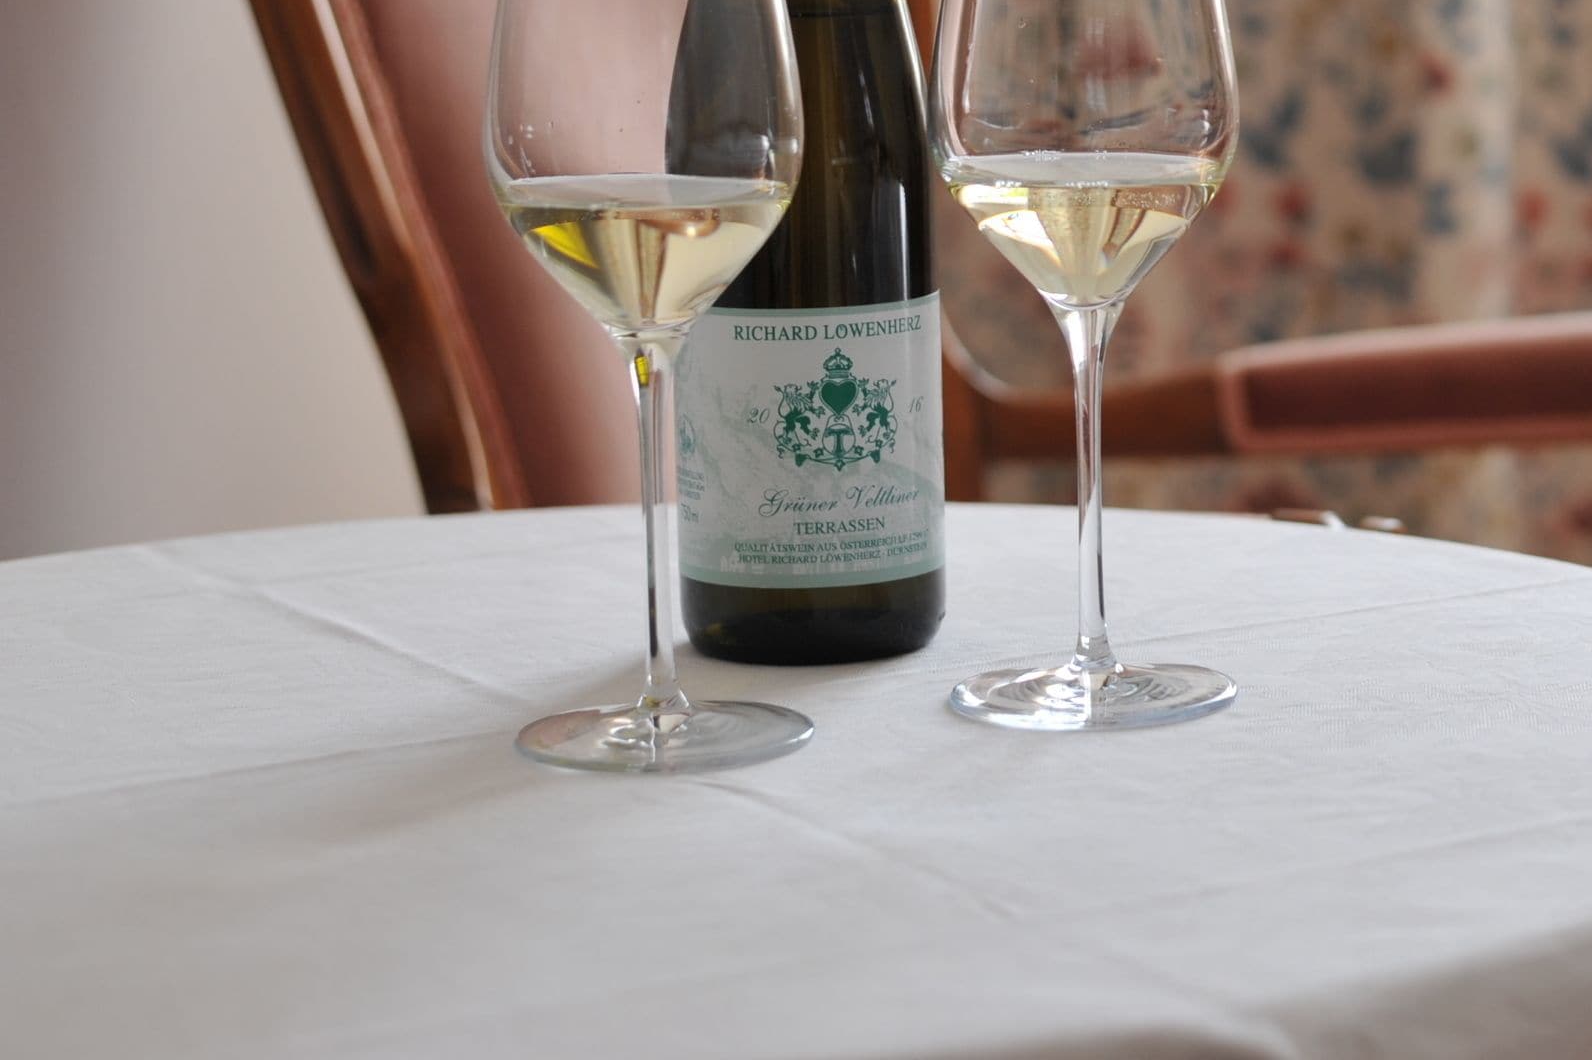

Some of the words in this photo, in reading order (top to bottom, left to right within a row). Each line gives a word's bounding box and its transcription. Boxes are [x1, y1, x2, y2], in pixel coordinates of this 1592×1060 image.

[734, 324, 817, 341] RICHARD
[909, 395, 925, 414] 16
[746, 407, 771, 425] 20
[758, 489, 839, 517] Grüner
[845, 484, 920, 510] Veltliner
[793, 516, 885, 536] TERRASSEN
[735, 542, 815, 553] QUALITÄTSWEIN
[816, 542, 837, 552] AUS
[738, 553, 769, 564] HOTEL
[771, 553, 818, 565] RICHARD
[820, 548, 881, 564] LÖWENHERZ
